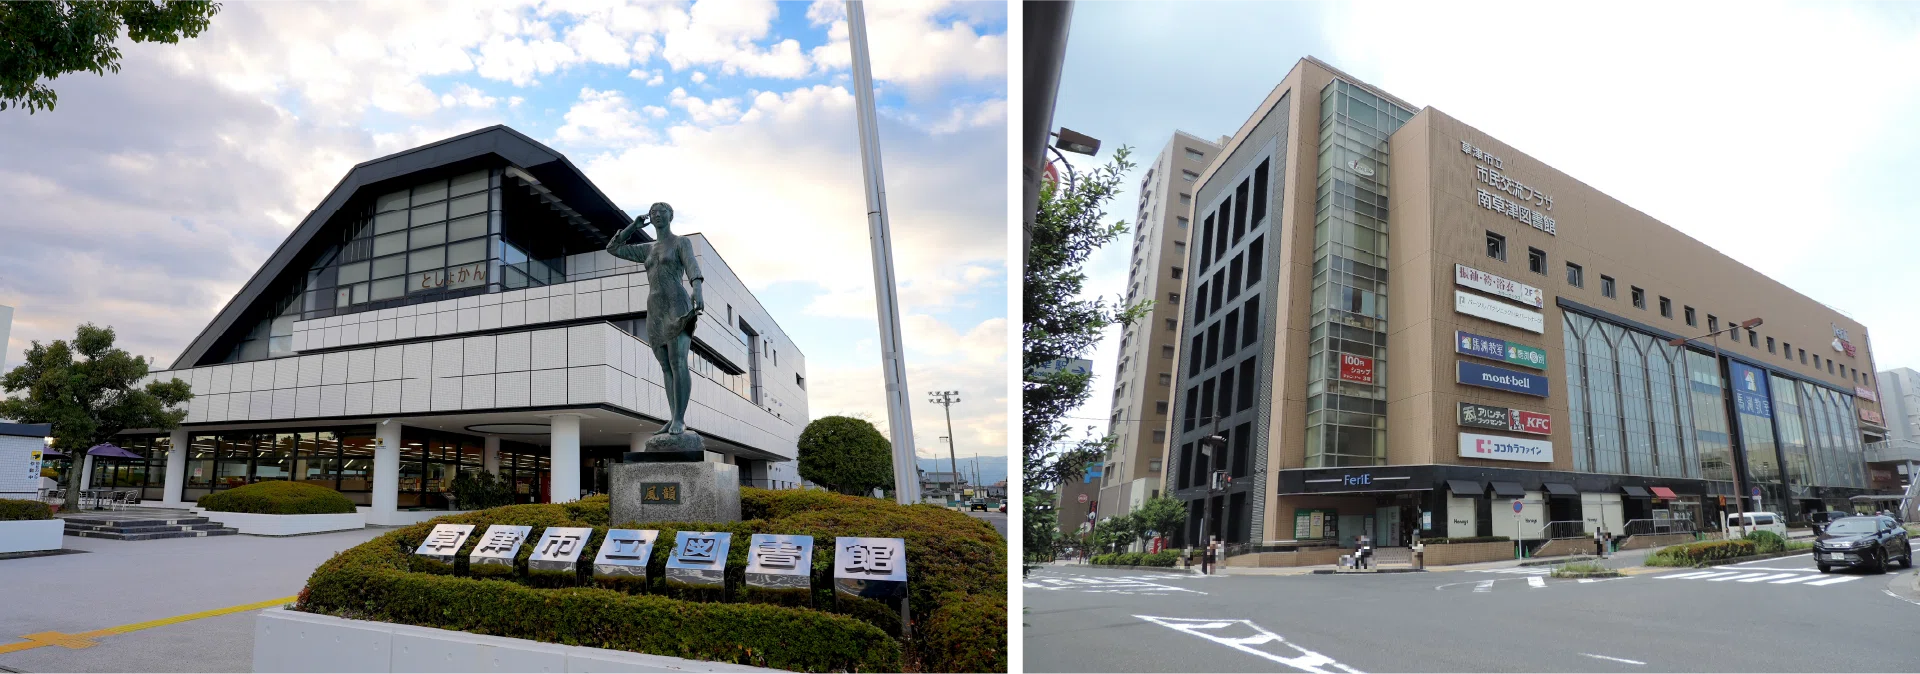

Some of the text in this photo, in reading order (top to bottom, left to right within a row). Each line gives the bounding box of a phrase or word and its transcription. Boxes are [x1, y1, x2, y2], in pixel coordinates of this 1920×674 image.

[1460, 140, 1504, 170] 草津市立
[1475, 164, 1554, 211] 市民交流プラザ
[1476, 187, 1557, 236] 南草津図書館
[421, 264, 486, 288] としょかん
[1524, 287, 1533, 297] 2F
[1351, 366, 1371, 376] ショップ
[1477, 407, 1506, 420] アバンティ
[1526, 417, 1549, 430] KFC
[1493, 443, 1542, 456] ココカラファイン
[1344, 474, 1371, 486] FeriE
[426, 524, 895, 574] 草津市立図書館
